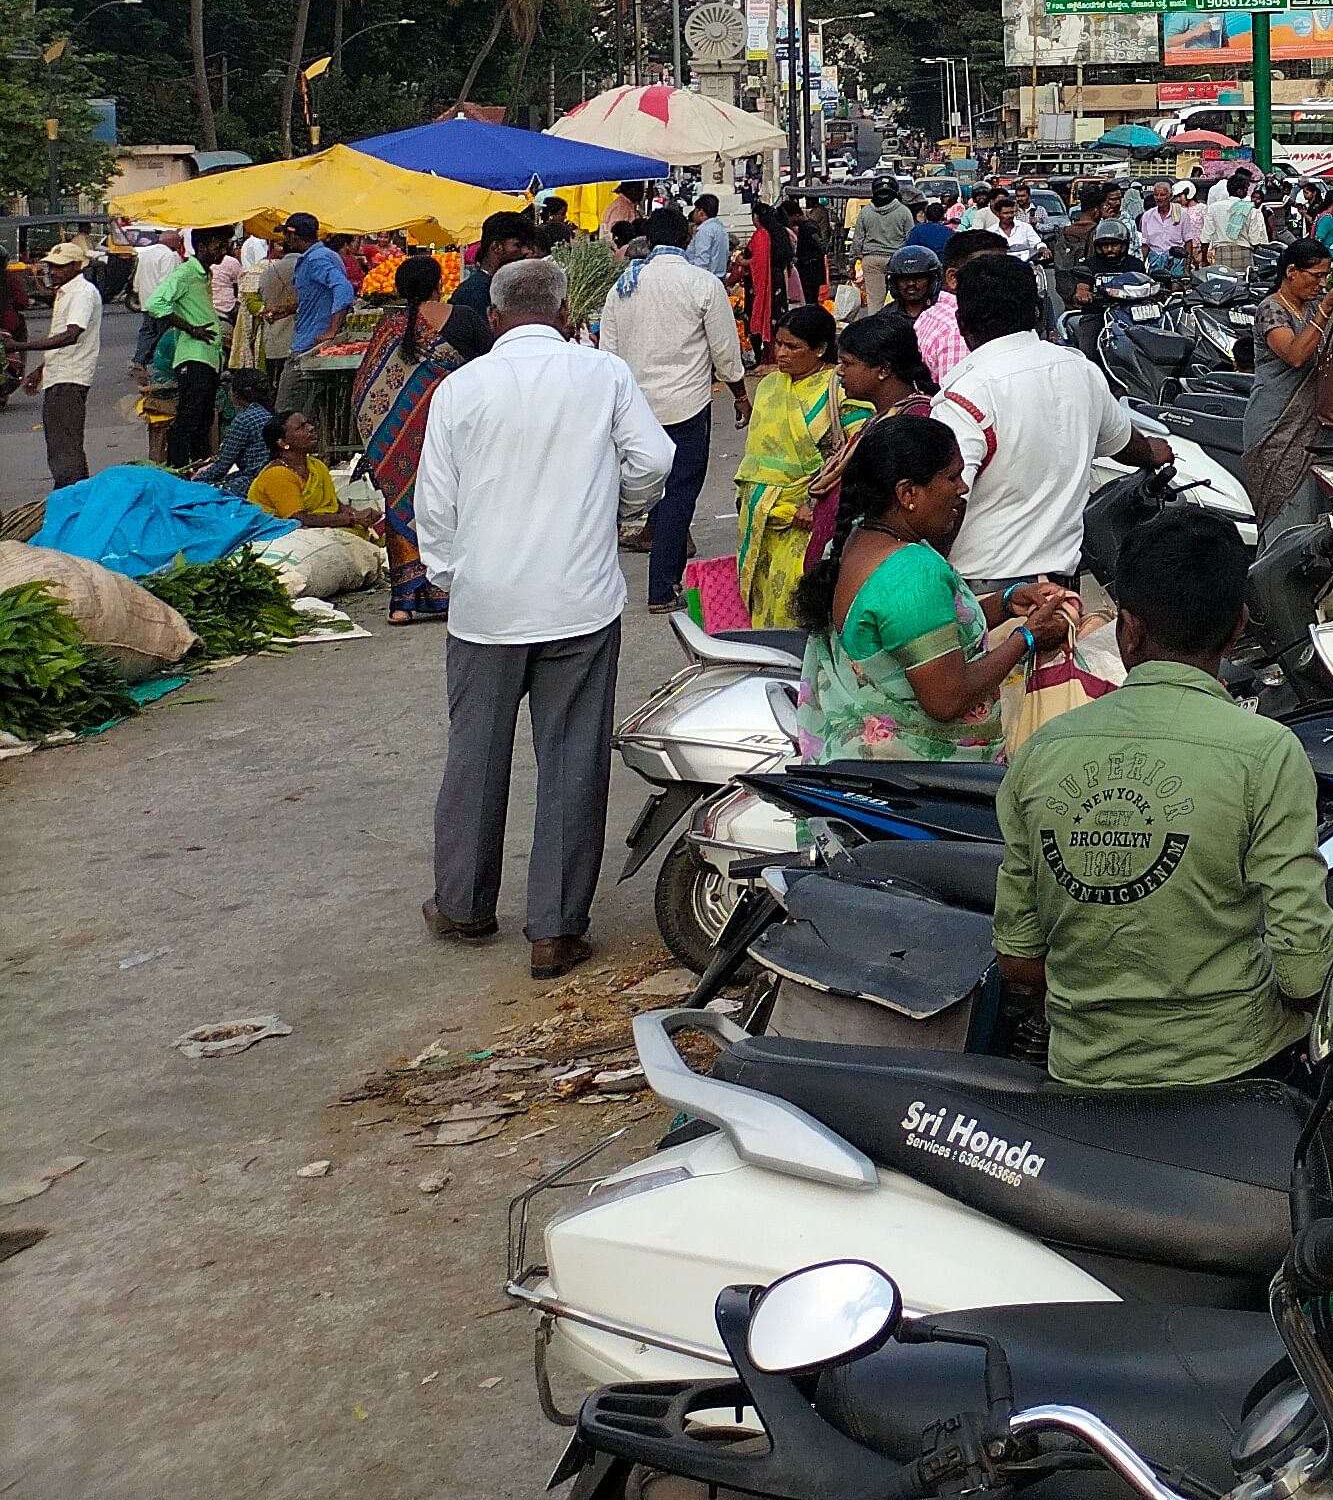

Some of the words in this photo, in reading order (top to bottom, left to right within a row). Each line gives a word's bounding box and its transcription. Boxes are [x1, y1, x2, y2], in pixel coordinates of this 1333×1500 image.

[1299, 112, 1325, 120] ANY
[1290, 152, 1332, 162] AYAKA
[1046, 752, 1195, 822] SUPERIOR
[1081, 788, 1115, 813] NEW
[1117, 787, 1151, 814] YORK
[1095, 811, 1135, 826] CITY
[1069, 831, 1152, 848] BROOKLYN
[1042, 837, 1129, 904] AUTHENTIC
[1133, 840, 1185, 898] DENIM
[1083, 851, 1132, 877] 1984
[901, 1101, 947, 1137] Sri
[947, 1113, 1046, 1178] Honda
[906, 1133, 951, 1158] Services
[959, 1150, 1023, 1187] 6364433666
